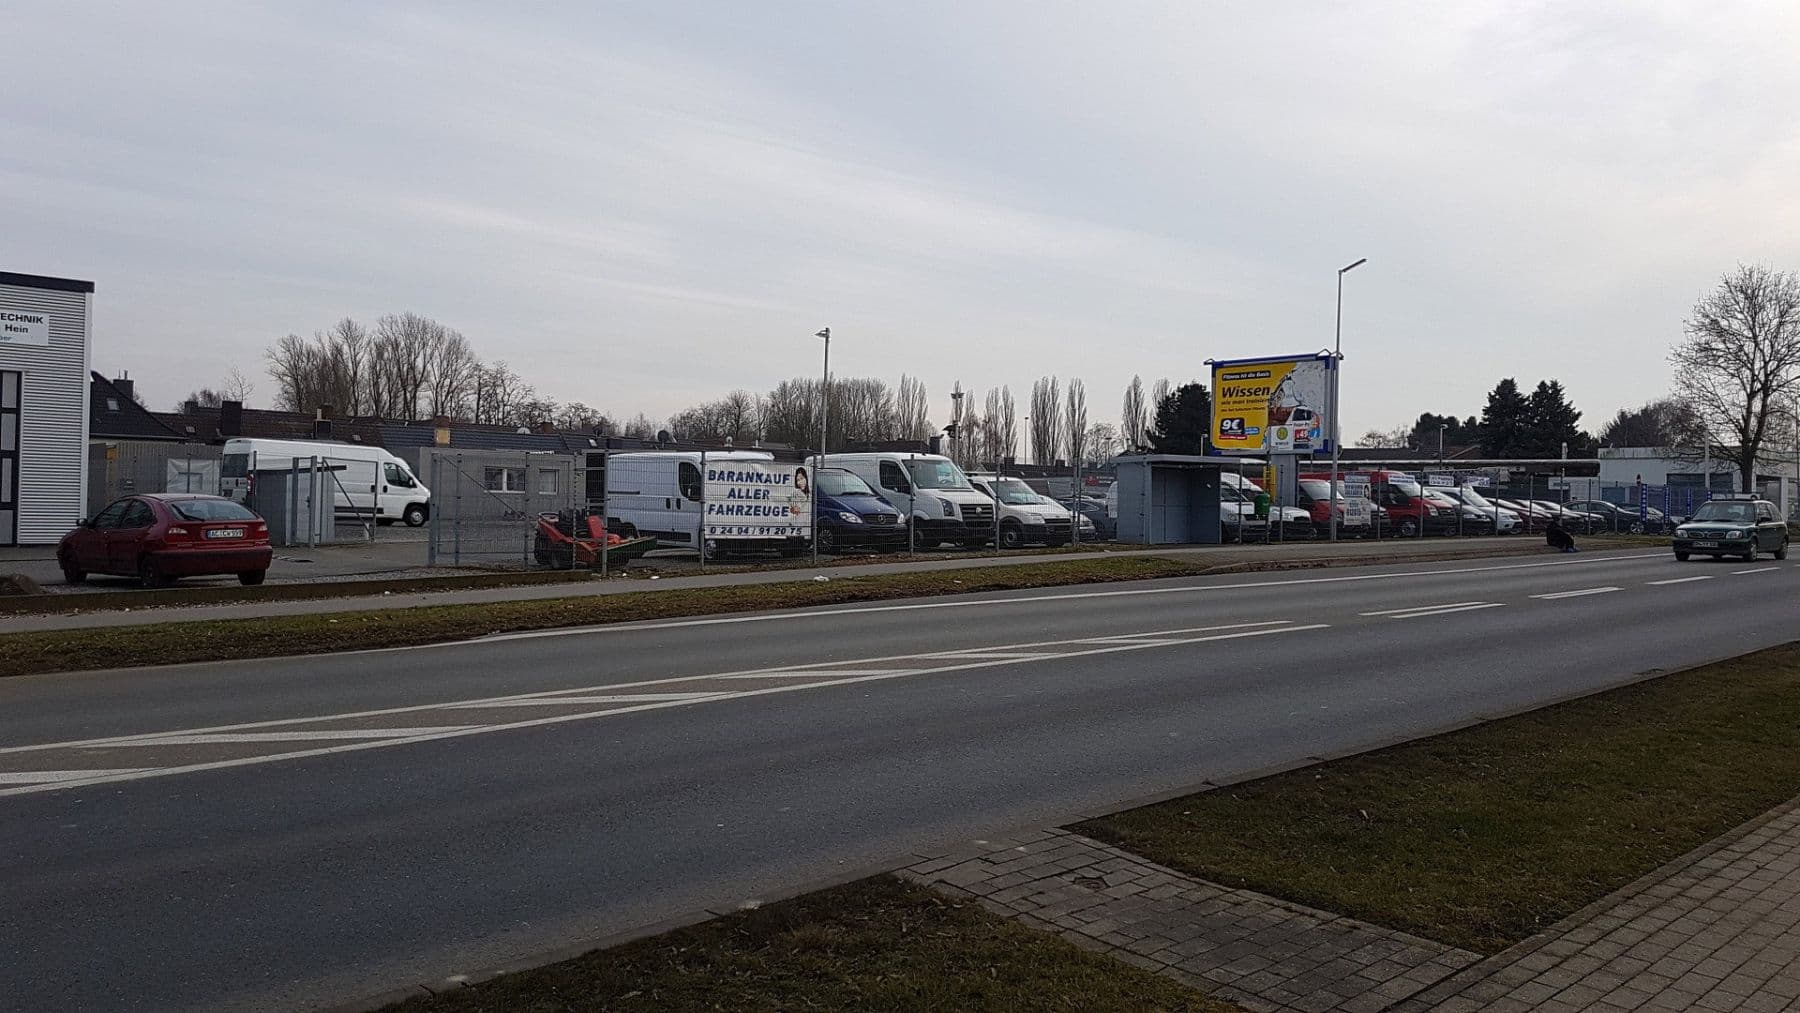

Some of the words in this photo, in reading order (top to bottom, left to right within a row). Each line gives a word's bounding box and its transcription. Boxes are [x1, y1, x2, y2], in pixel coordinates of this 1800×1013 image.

[5, 324, 29, 333] Hein
[1222, 386, 1270, 398] Wissen
[1221, 418, 1240, 430] 9€
[708, 469, 790, 485] BARANKAUF
[727, 487, 770, 500] ALLER
[708, 503, 790, 517] FAHRZEUGE
[720, 526, 733, 535] 24
[737, 526, 749, 535] 04
[759, 527, 770, 535] 91
[774, 527, 786, 535] 20
[790, 527, 802, 535] 75
